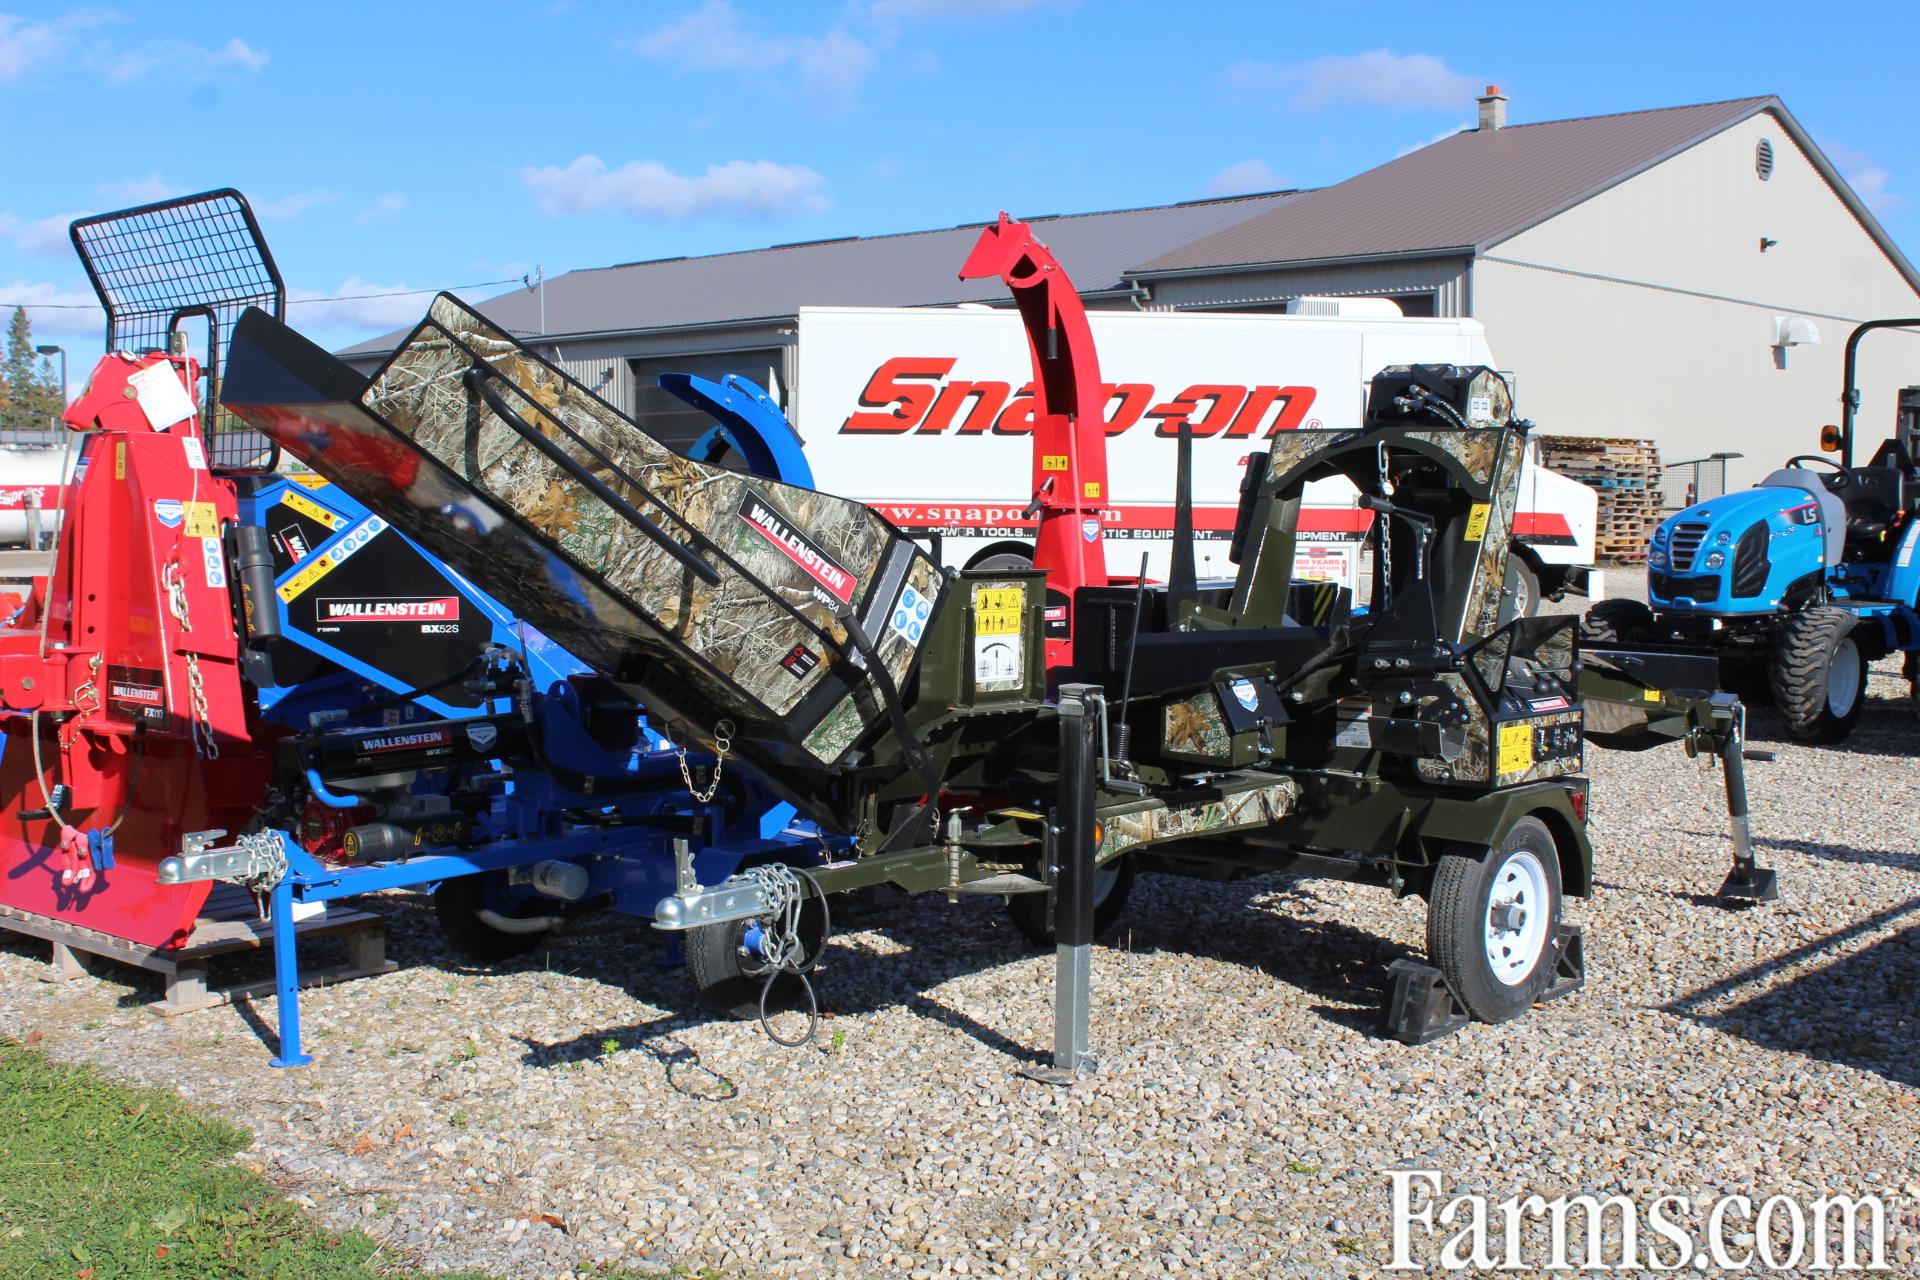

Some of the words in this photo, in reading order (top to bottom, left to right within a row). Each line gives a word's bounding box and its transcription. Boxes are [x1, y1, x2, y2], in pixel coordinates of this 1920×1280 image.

[1802, 507, 1817, 524] LS
[980, 527, 1033, 537] TOOLS...
[750, 503, 846, 590] WALLENSTEIN
[328, 602, 447, 617] WALLENSTEIN
[421, 624, 460, 634] BX52S
[112, 685, 160, 701] WALLENSTEIN
[362, 731, 443, 751] WALLENSTEIN
